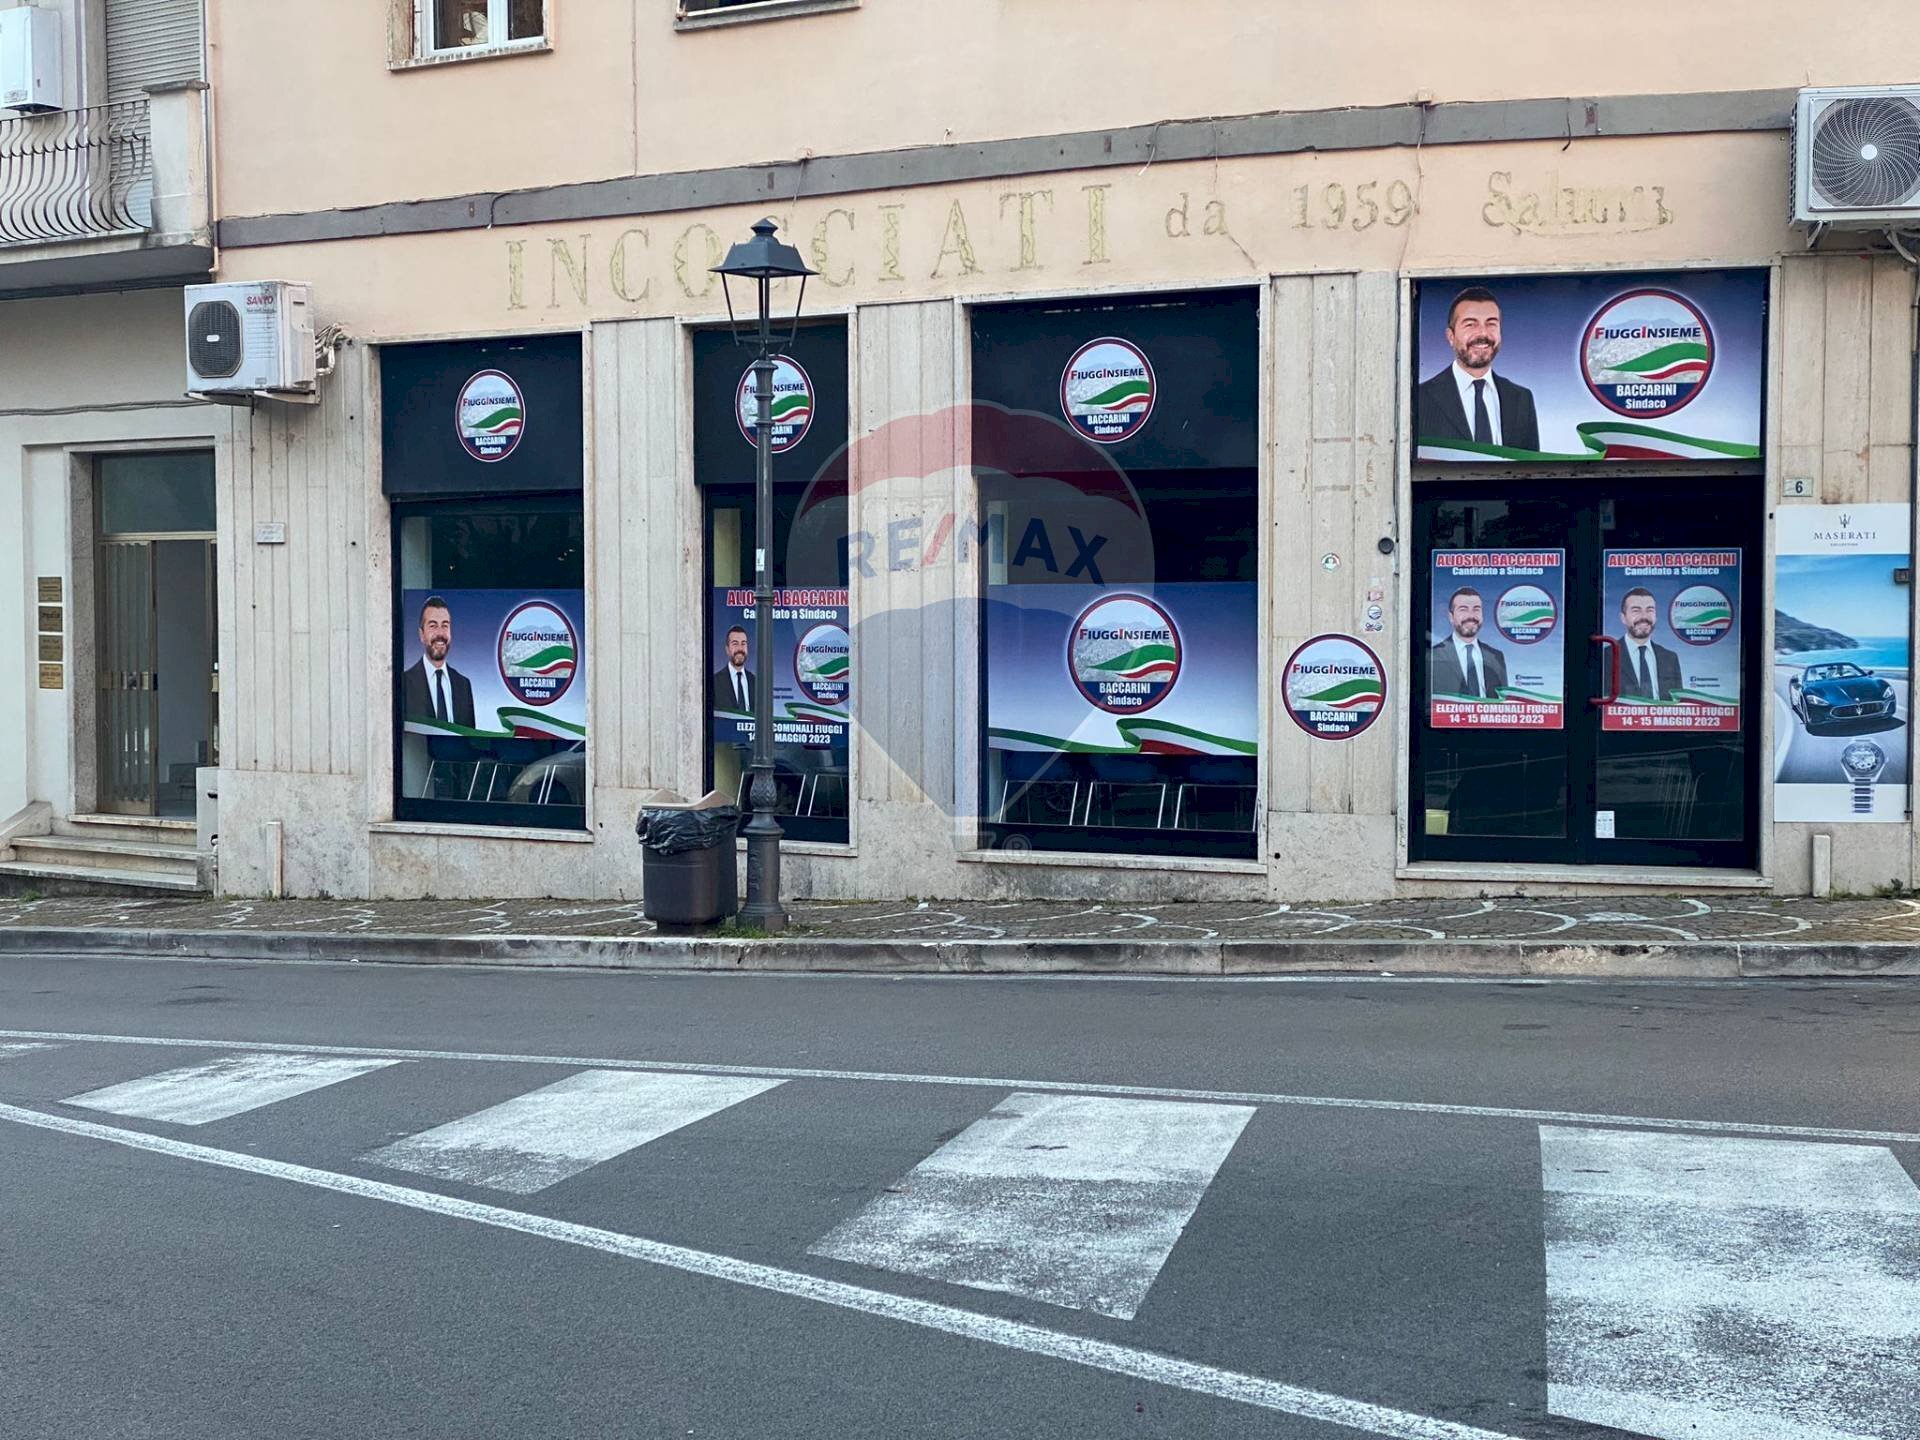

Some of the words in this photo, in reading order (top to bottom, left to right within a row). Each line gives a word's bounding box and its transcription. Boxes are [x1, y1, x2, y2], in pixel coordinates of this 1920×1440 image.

[505, 182, 1112, 312] INCOCIATI
[1165, 190, 1230, 239] da
[1290, 179, 1415, 233] 1959
[246, 295, 274, 306] SANYO
[1616, 383, 1677, 397] BACCARINI
[1625, 398, 1667, 409] Sindaco
[1087, 413, 1130, 425] BACCARINI
[1094, 425, 1123, 435] Sindaco
[475, 436, 506, 446] BACCARINI
[1795, 480, 1803, 494] 6
[1814, 531, 1876, 540] MASERATI
[1436, 553, 1488, 567] ALIOSKA
[1491, 553, 1560, 567] BACCARINI
[1608, 554, 1663, 567] ALIOSKA
[1664, 553, 1736, 567] BACCARINI
[1452, 567, 1498, 576] Candidato
[1507, 567, 1543, 576] Sindaco
[1624, 567, 1672, 576] Candidato
[1681, 567, 1719, 576] Sindaco
[726, 590, 780, 607] ALIOA
[783, 590, 849, 607] BACCARIN
[791, 610, 798, 619] a
[799, 608, 837, 620] Sindaco
[519, 677, 556, 688] BACCARINI
[812, 682, 844, 691] BACCARINI
[1099, 682, 1150, 694] BACCARINI
[525, 689, 550, 699] Sindaco
[817, 691, 839, 699] Sindaco
[1107, 695, 1142, 705] Sindaco
[1436, 704, 1475, 713] ELEZIONI
[1476, 704, 1525, 713] COMUNALI
[1527, 704, 1558, 714] FIUGGI
[1608, 706, 1648, 716] ELEZIONI
[1650, 706, 1700, 716] COMUNALI
[1701, 706, 1734, 716] FIUGGI
[1309, 711, 1358, 723] BACCARINI
[1450, 714, 1459, 723] 14
[1467, 714, 1478, 723] 15
[1480, 714, 1518, 723] MAGGIO
[1519, 714, 1544, 724] 2023
[1622, 717, 1633, 726] 14
[1641, 717, 1652, 726] 15
[1653, 717, 1693, 726] MAGGIO
[1695, 717, 1720, 727] 2023
[736, 722, 756, 732] ELEZI
[815, 724, 843, 735] FIUGGI
[1317, 723, 1350, 733] Sindaco
[774, 733, 808, 743] MAGGIO
[808, 734, 831, 744] 2023
